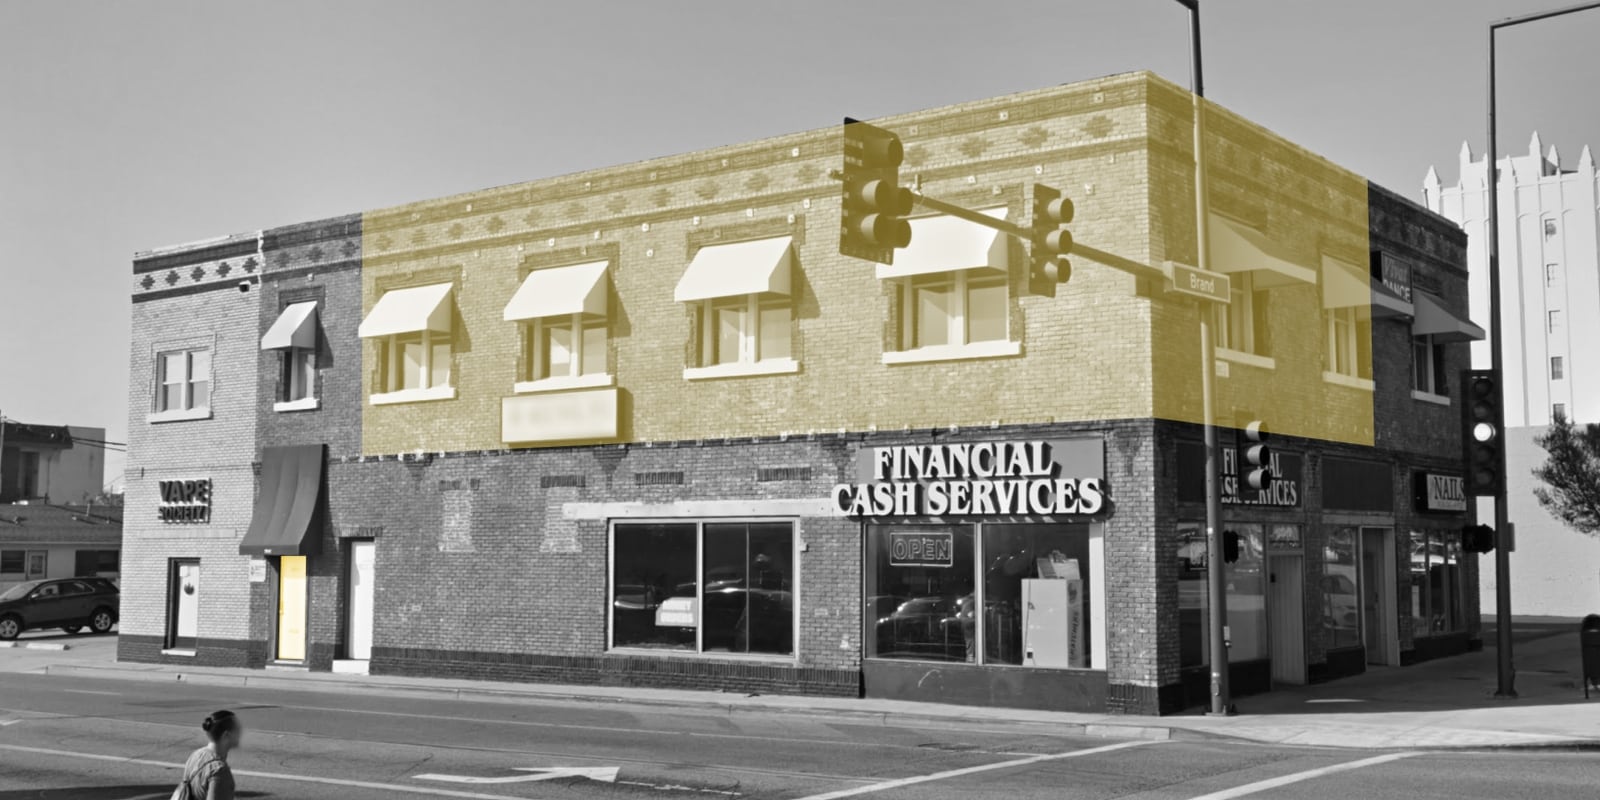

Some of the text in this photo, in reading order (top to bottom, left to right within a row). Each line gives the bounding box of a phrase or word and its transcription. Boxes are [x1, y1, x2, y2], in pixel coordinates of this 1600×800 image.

[1189, 272, 1215, 294] Brand
[873, 441, 1054, 480] FINANCIAL
[158, 480, 209, 503] VAPE
[831, 478, 1103, 517] CASH SERVICES
[1244, 479, 1297, 506] RVICES
[1433, 476, 1465, 502] NAILS
[892, 537, 951, 560] OPEN
